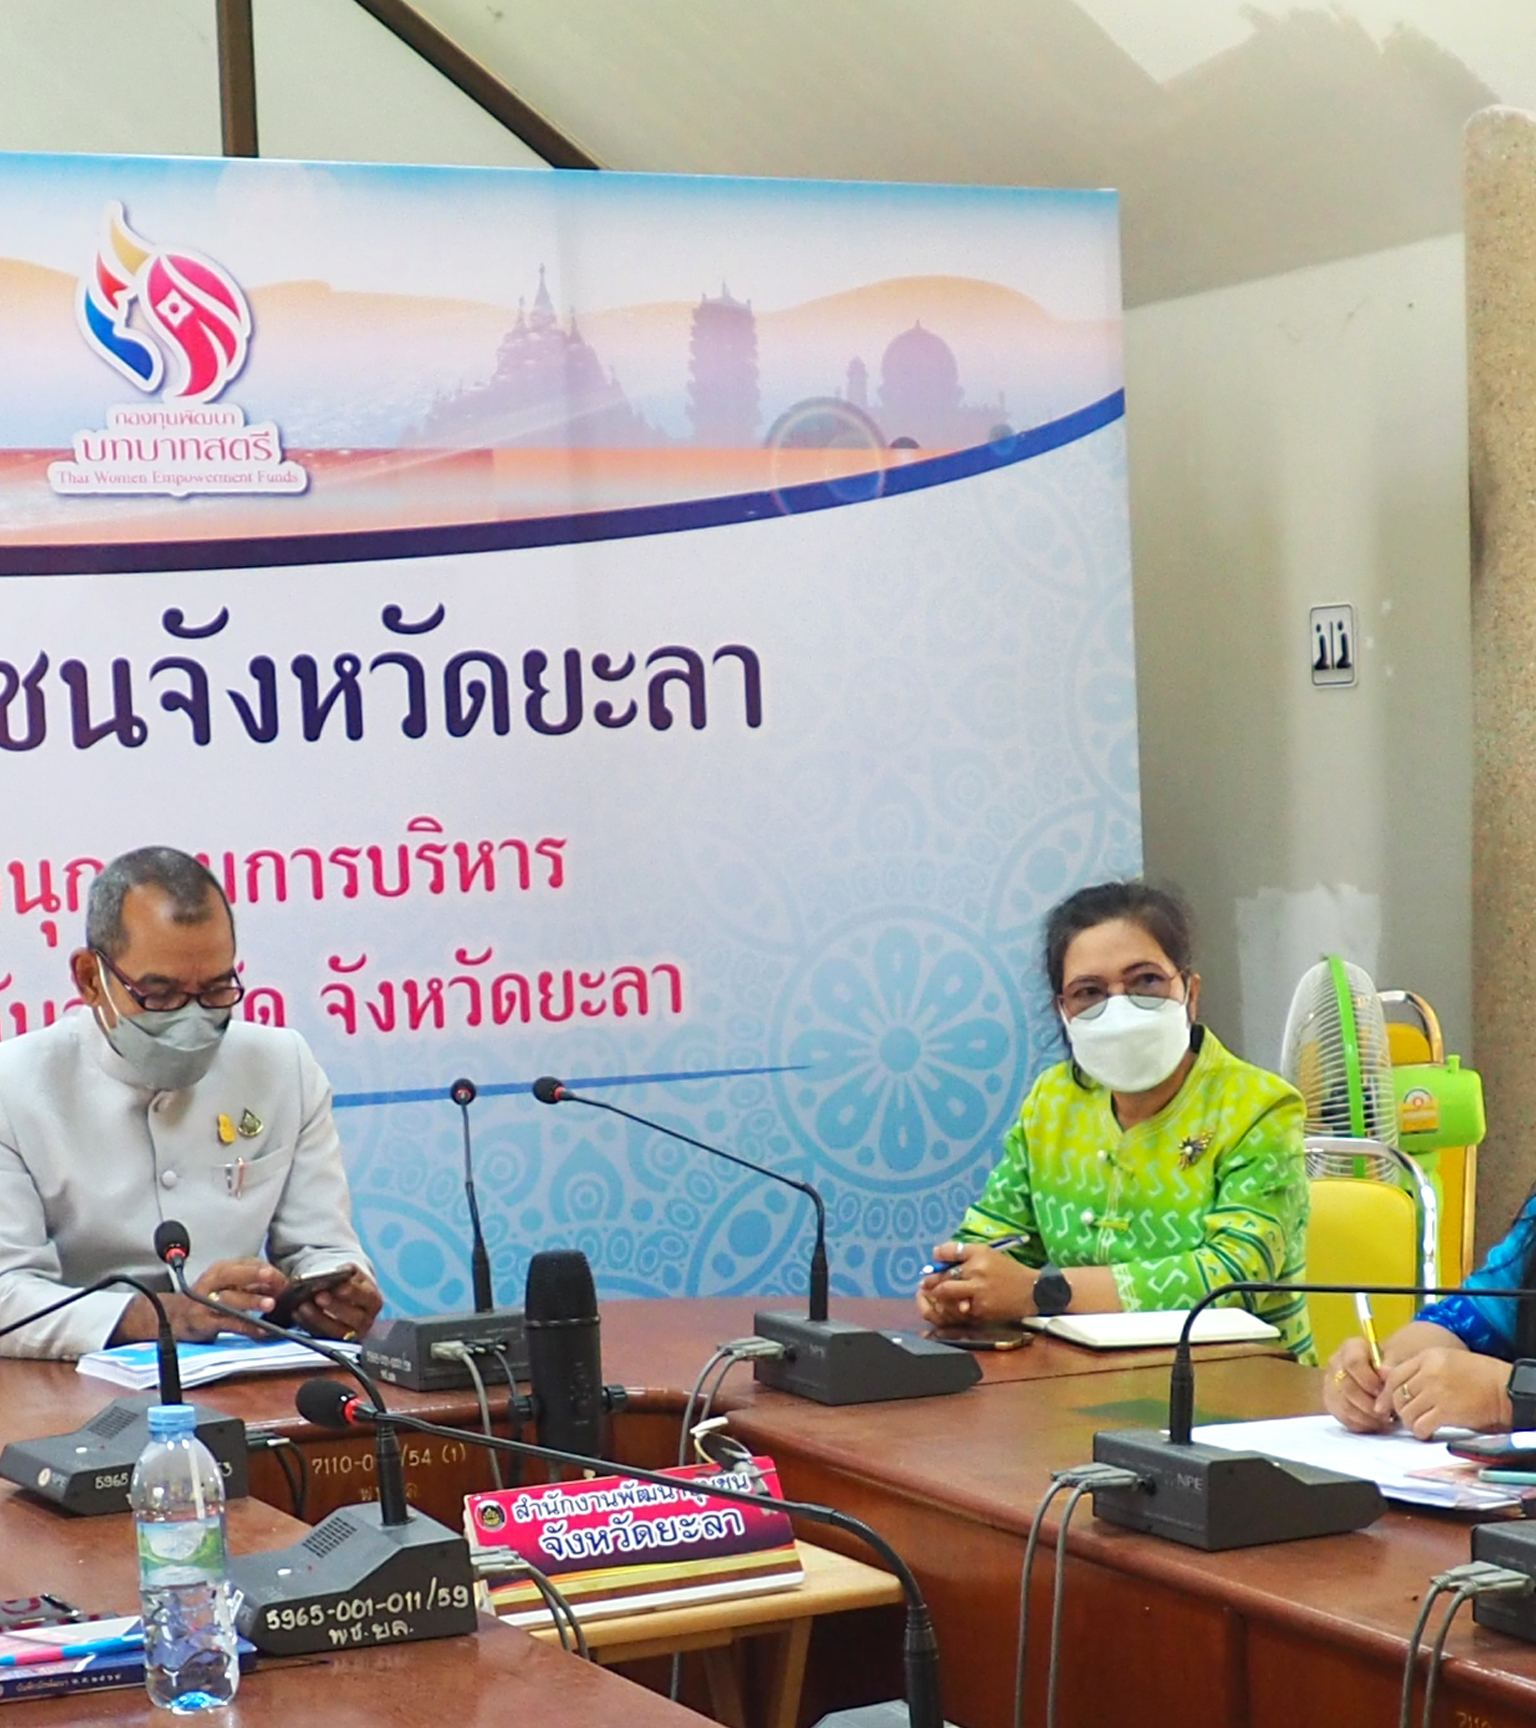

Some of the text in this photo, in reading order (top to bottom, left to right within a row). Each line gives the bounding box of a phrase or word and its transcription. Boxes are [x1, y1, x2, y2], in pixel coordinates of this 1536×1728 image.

[115, 409, 235, 430] กองทุนพัฒนา
[83, 431, 272, 462] บทบาทสตรี
[95, 471, 148, 484] Women
[258, 471, 298, 484] Funds
[322, 946, 684, 1036] จังหวัดยะลา
[515, 1473, 749, 1519] สำนักงานพัฒนุชน
[1177, 1473, 1204, 1492] NPE
[543, 1511, 742, 1557] จังหวัดยะลา
[266, 1576, 470, 1630] 5965-001-011/59
